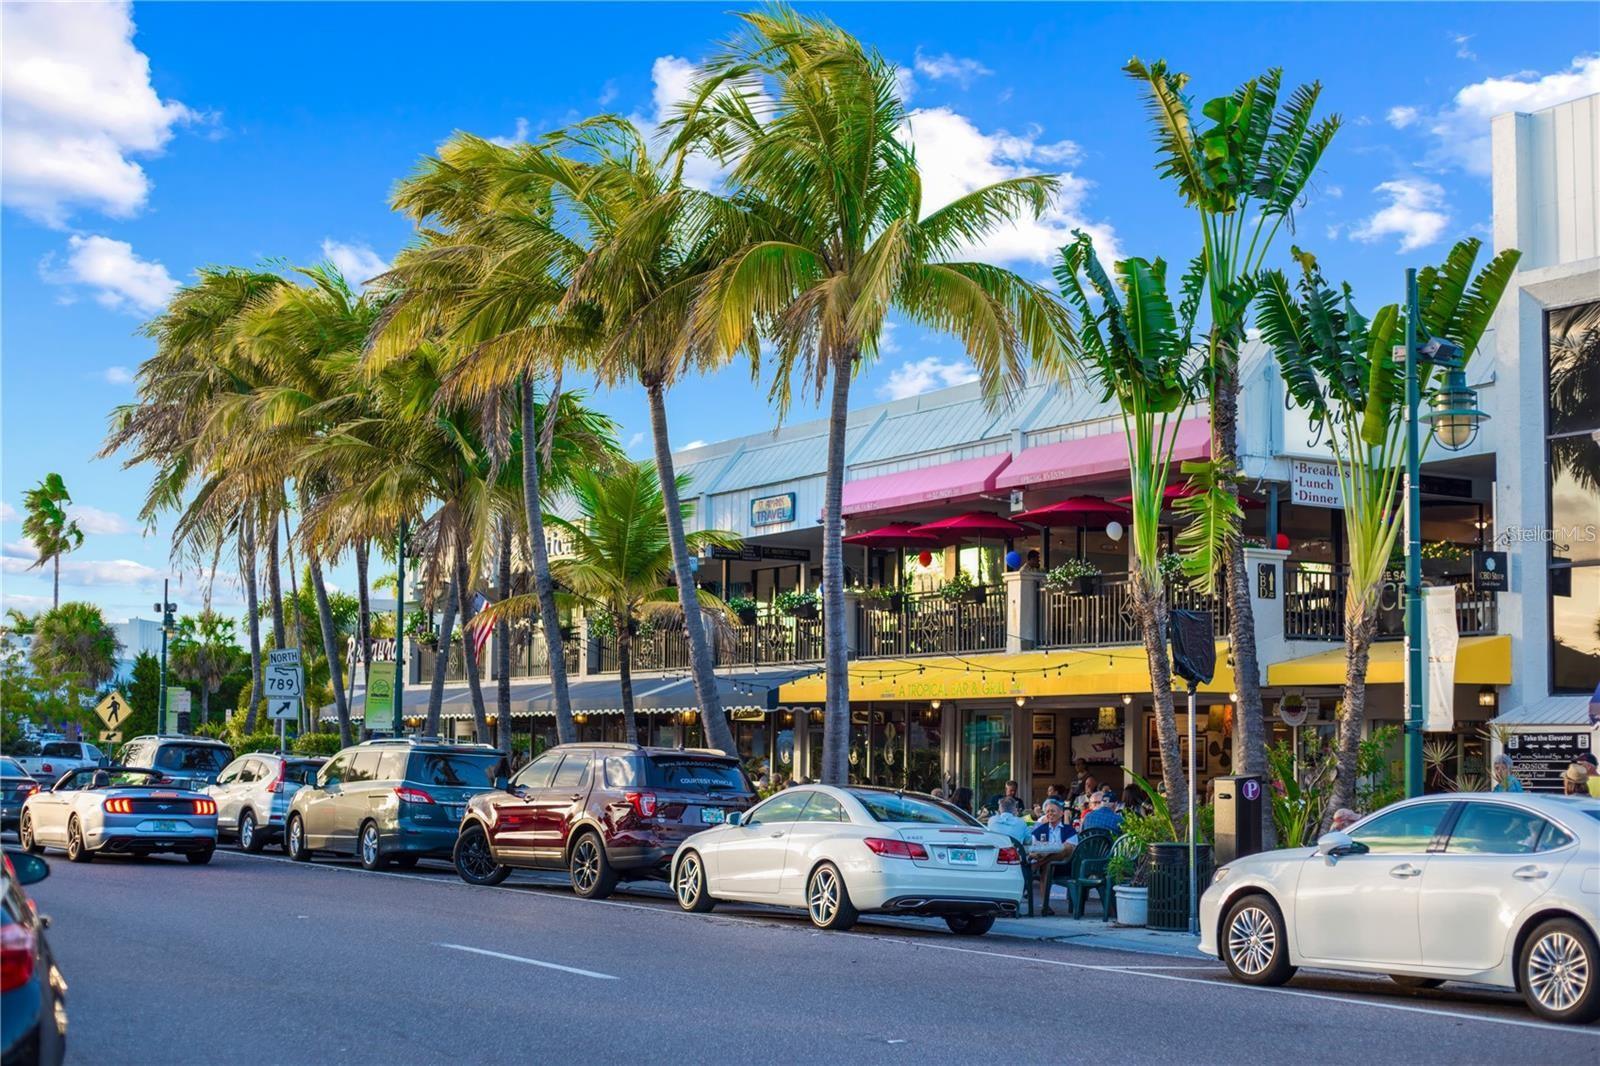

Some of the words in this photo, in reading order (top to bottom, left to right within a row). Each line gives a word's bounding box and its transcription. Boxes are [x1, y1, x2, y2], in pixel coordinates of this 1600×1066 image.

[1299, 463, 1352, 478] Breakfs
[1299, 477, 1333, 490] Lunch
[1299, 490, 1338, 505] Dinner
[756, 508, 787, 521] TRAVEL
[1259, 563, 1268, 598] CBD
[1480, 571, 1491, 580] CBD
[1491, 571, 1504, 580] Store
[270, 652, 298, 664] NORTH
[268, 678, 294, 690] 789
[899, 685, 906, 697] A
[908, 682, 948, 697] TROPICAL
[951, 681, 969, 696] BAR
[982, 680, 1007, 695] GRILL
[1247, 782, 1258, 798] P
